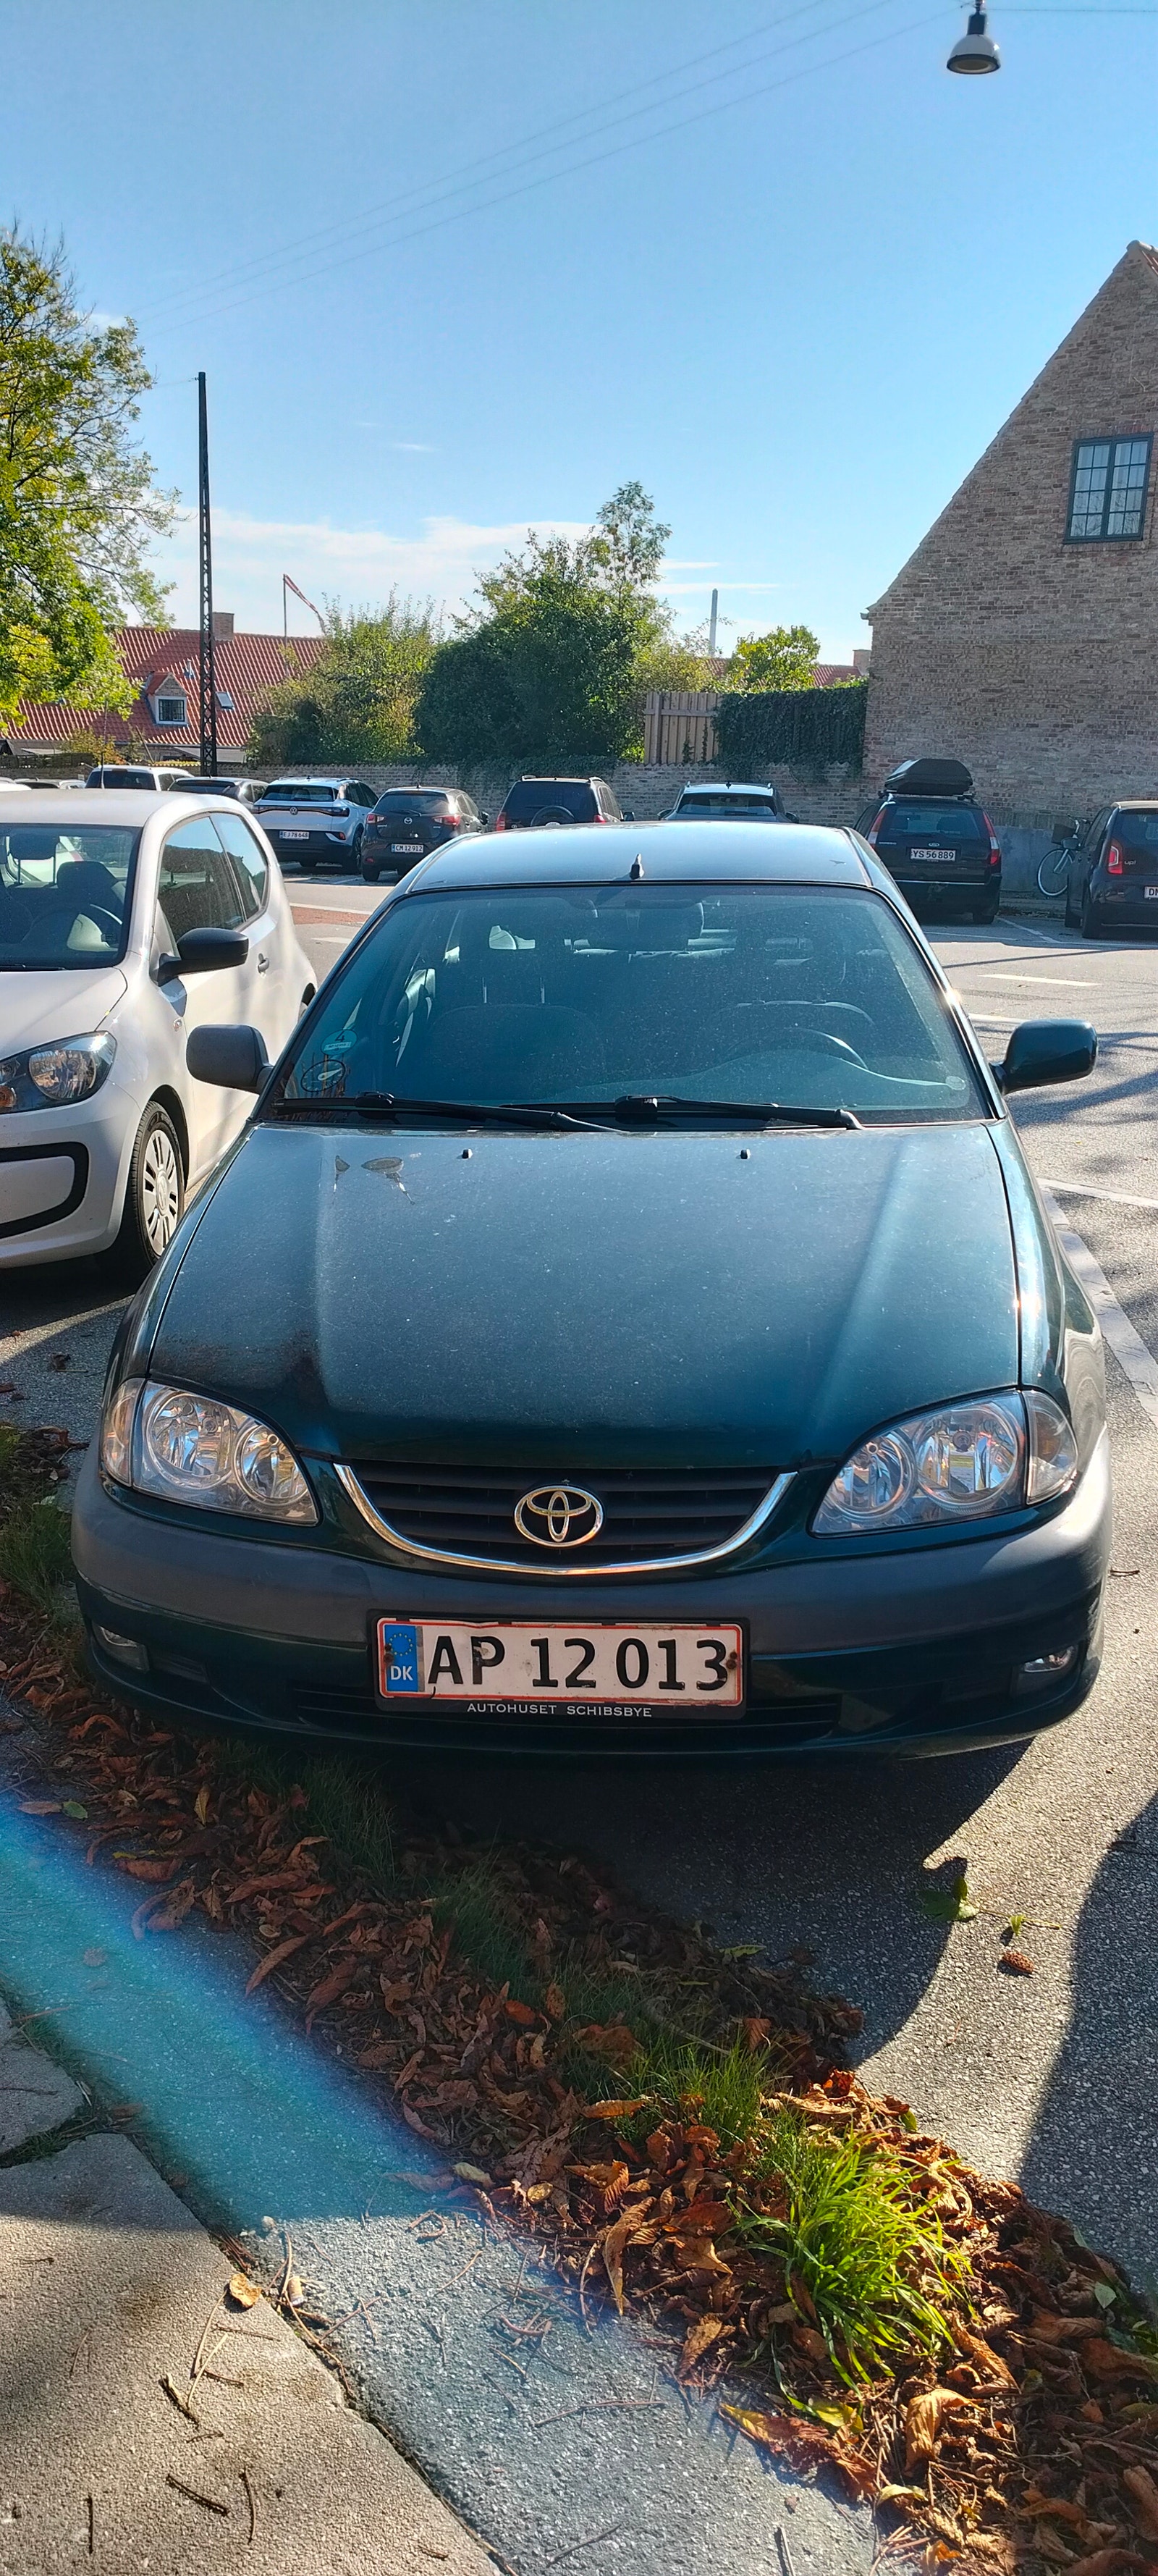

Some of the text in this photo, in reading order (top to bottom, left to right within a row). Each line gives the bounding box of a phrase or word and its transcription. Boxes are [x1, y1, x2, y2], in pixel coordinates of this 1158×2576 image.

[938, 851, 954, 859] 889
[334, 1030, 346, 1043] 4
[428, 1636, 728, 1691] AP 12 013
[389, 1665, 414, 1681] DK
[467, 1703, 652, 1717] AUTOHUSET SCHIBSBYE
